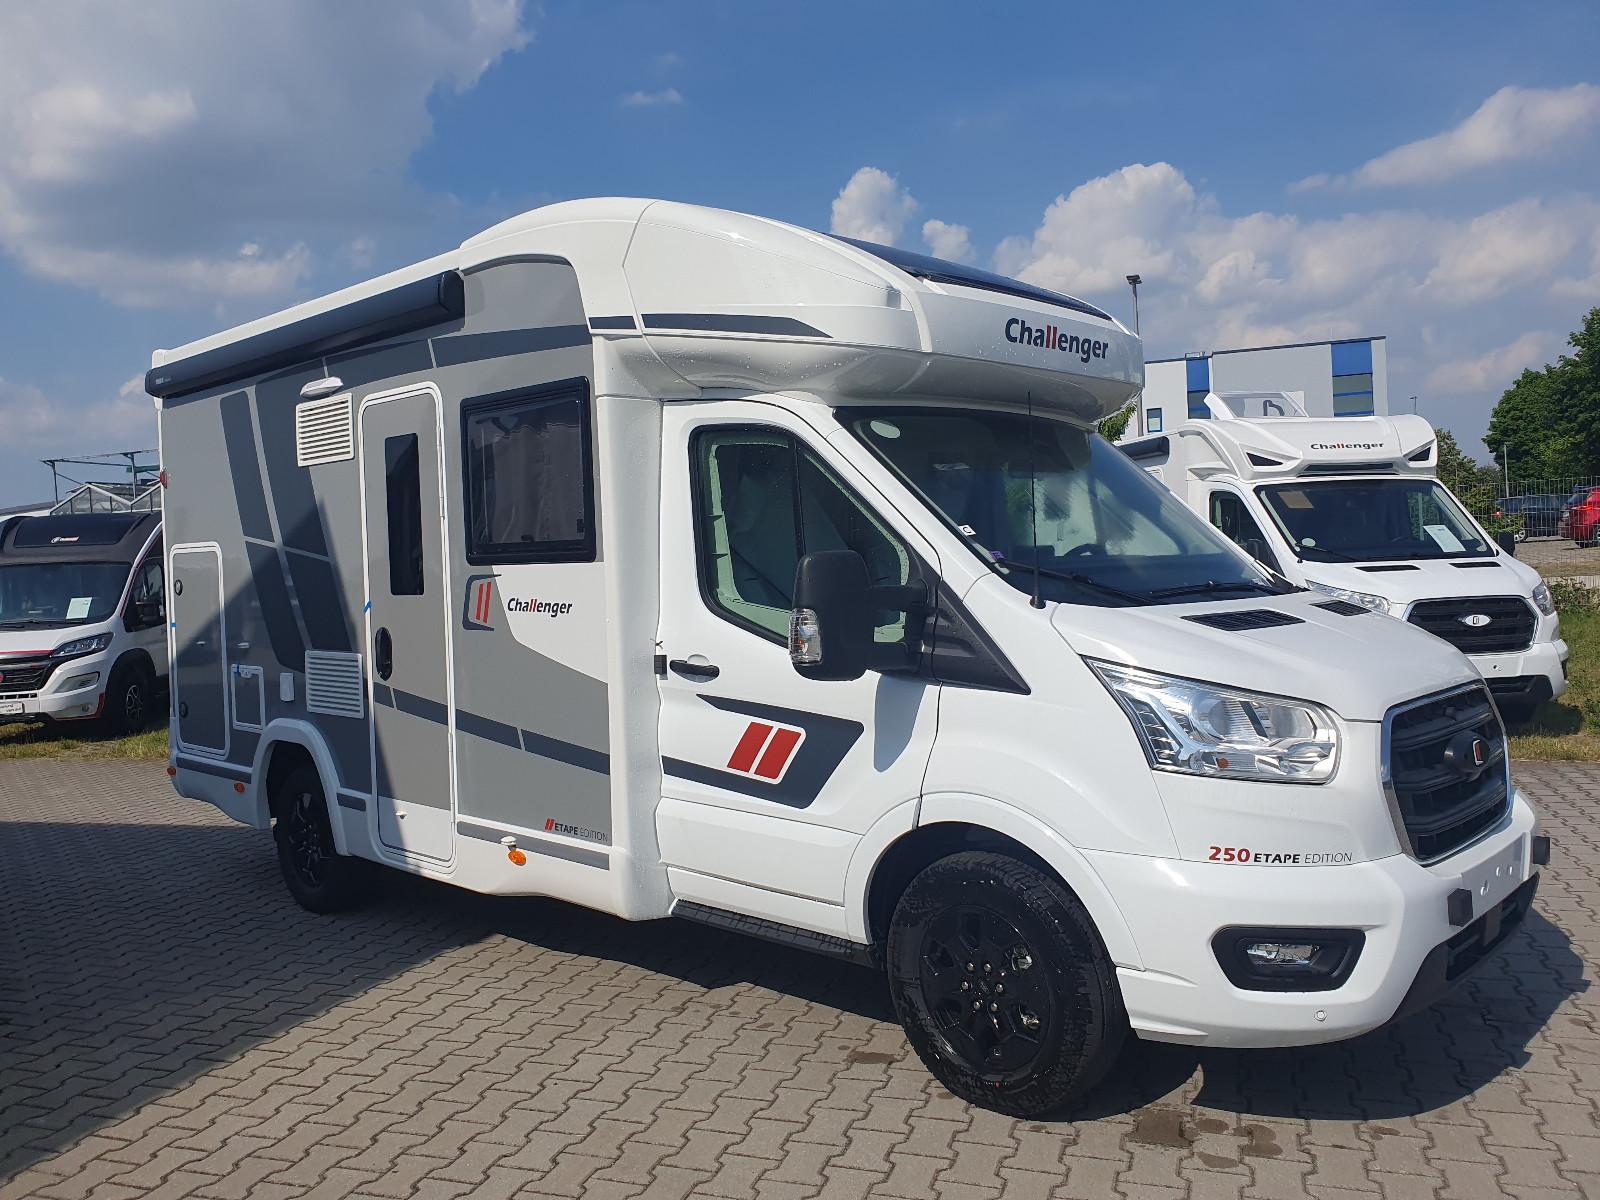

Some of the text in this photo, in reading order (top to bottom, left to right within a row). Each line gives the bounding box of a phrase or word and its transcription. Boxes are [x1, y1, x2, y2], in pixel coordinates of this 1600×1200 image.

[1005, 318, 1108, 363] Challenger
[507, 597, 573, 618] Challenger
[555, 822, 608, 842] ETAPE EDITION
[1208, 846, 1353, 864] 250 ETAPE EDITION
